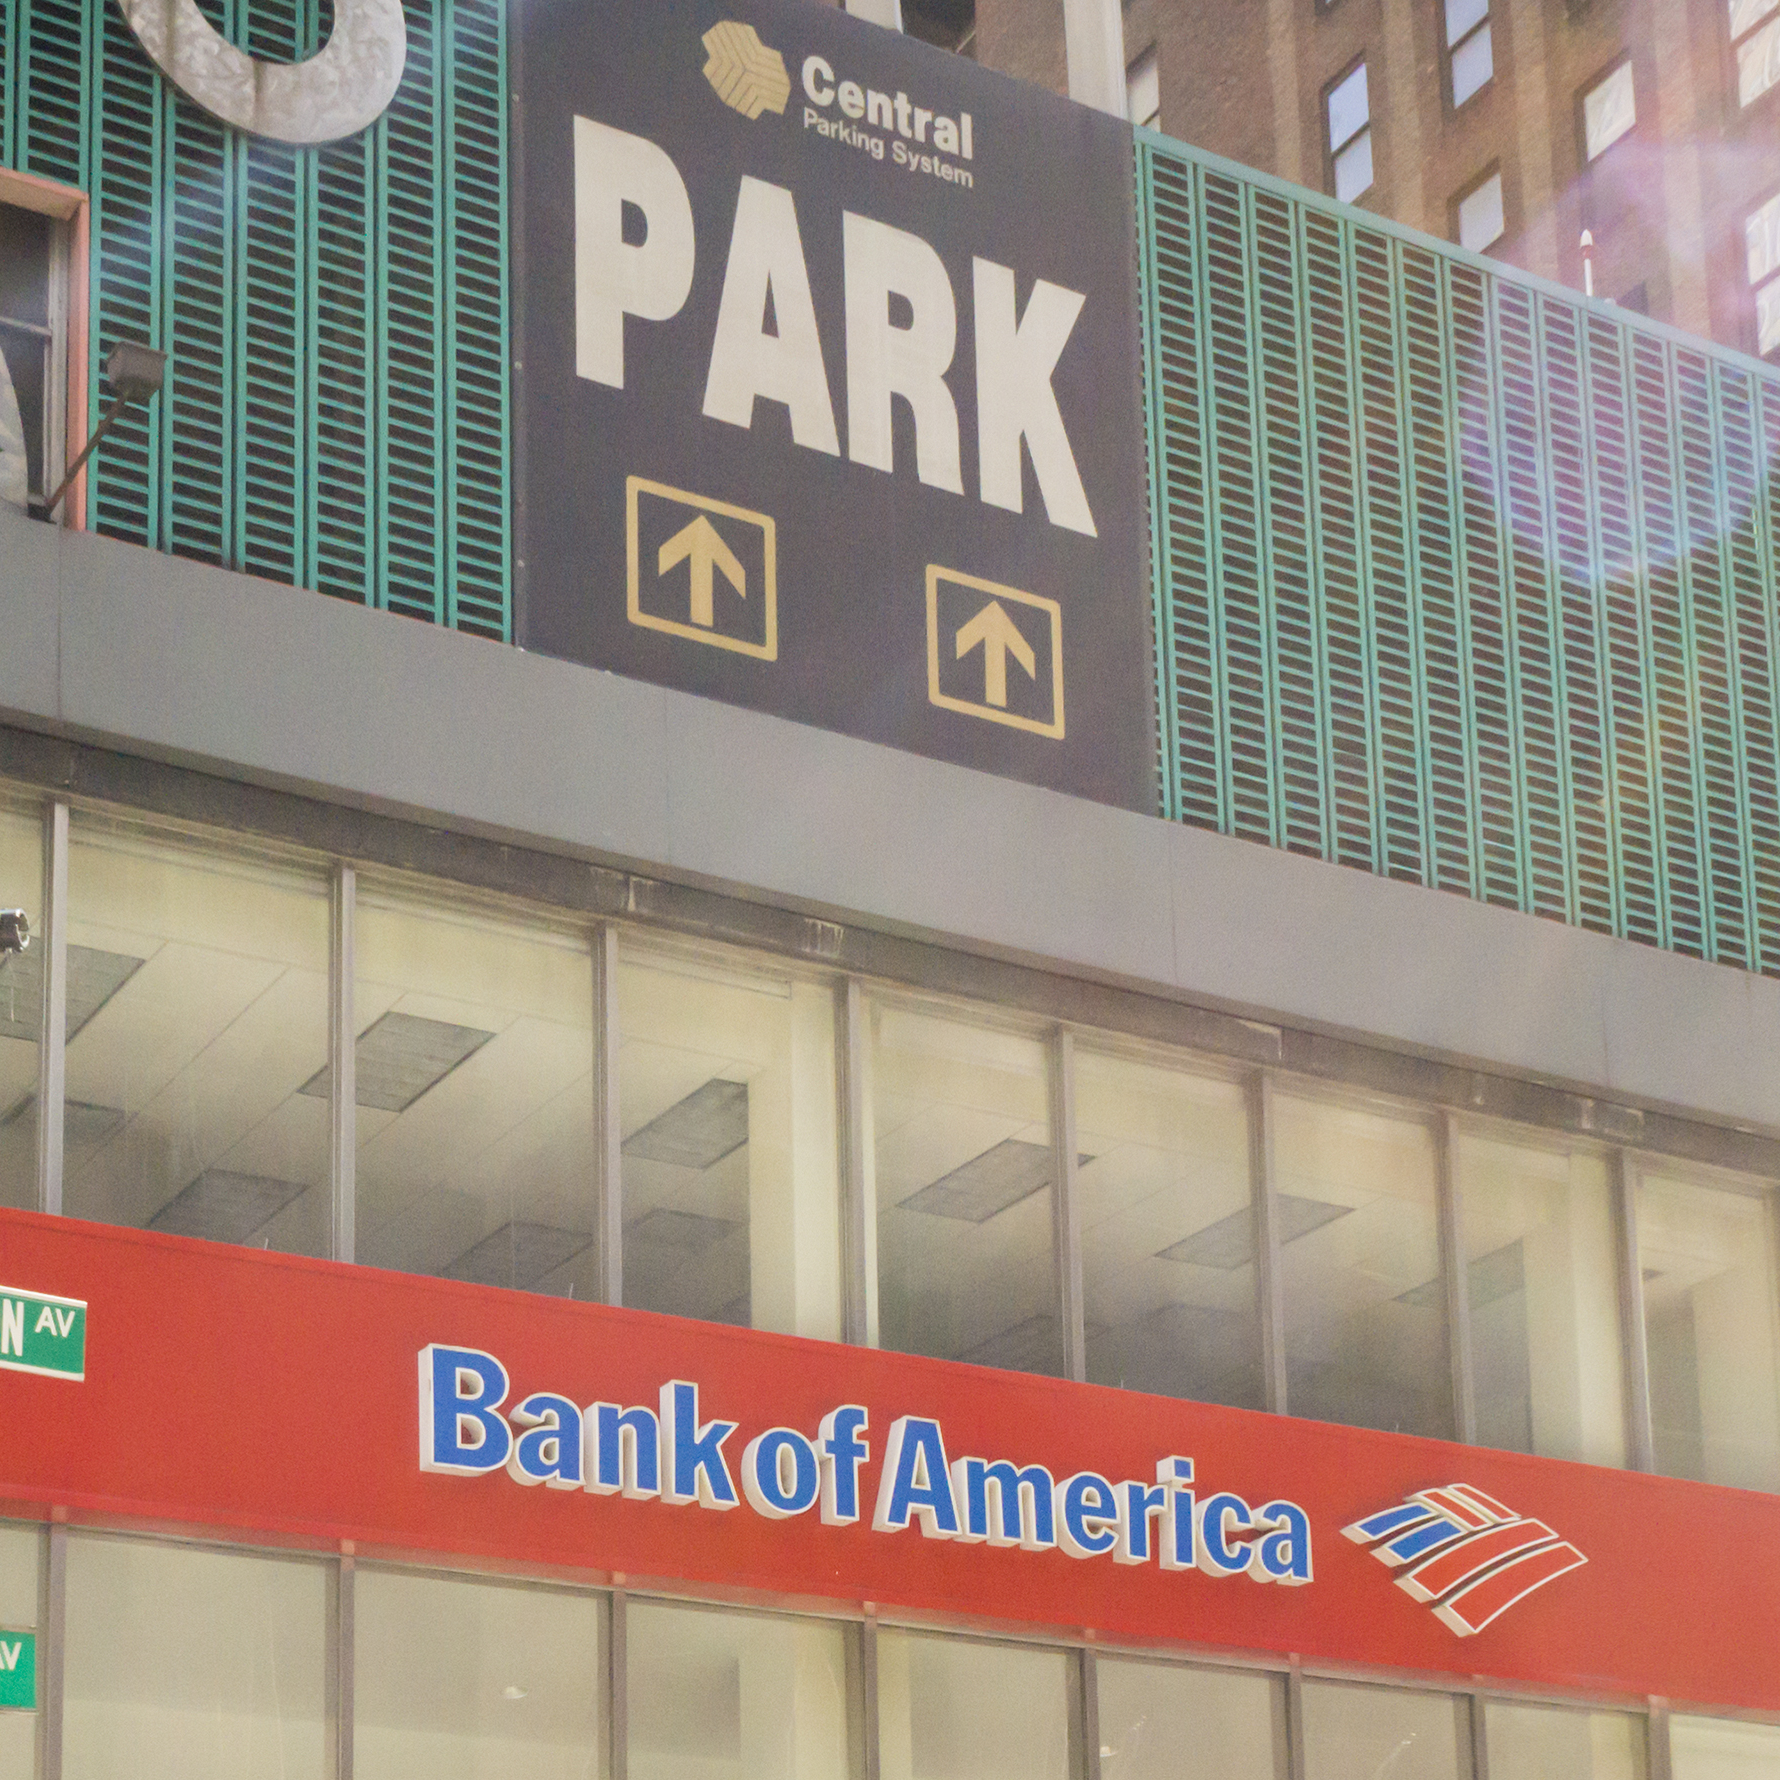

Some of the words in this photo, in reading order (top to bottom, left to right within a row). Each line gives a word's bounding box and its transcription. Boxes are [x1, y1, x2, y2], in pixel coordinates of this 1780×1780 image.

[802, 55, 973, 160] Central
[803, 108, 885, 159] Parking
[892, 140, 974, 188] System
[573, 114, 1097, 538] PARK
[35, 1306, 76, 1339] AV
[418, 1343, 738, 1510] Bank
[741, 1403, 870, 1526] of
[870, 1415, 1314, 1587] America
